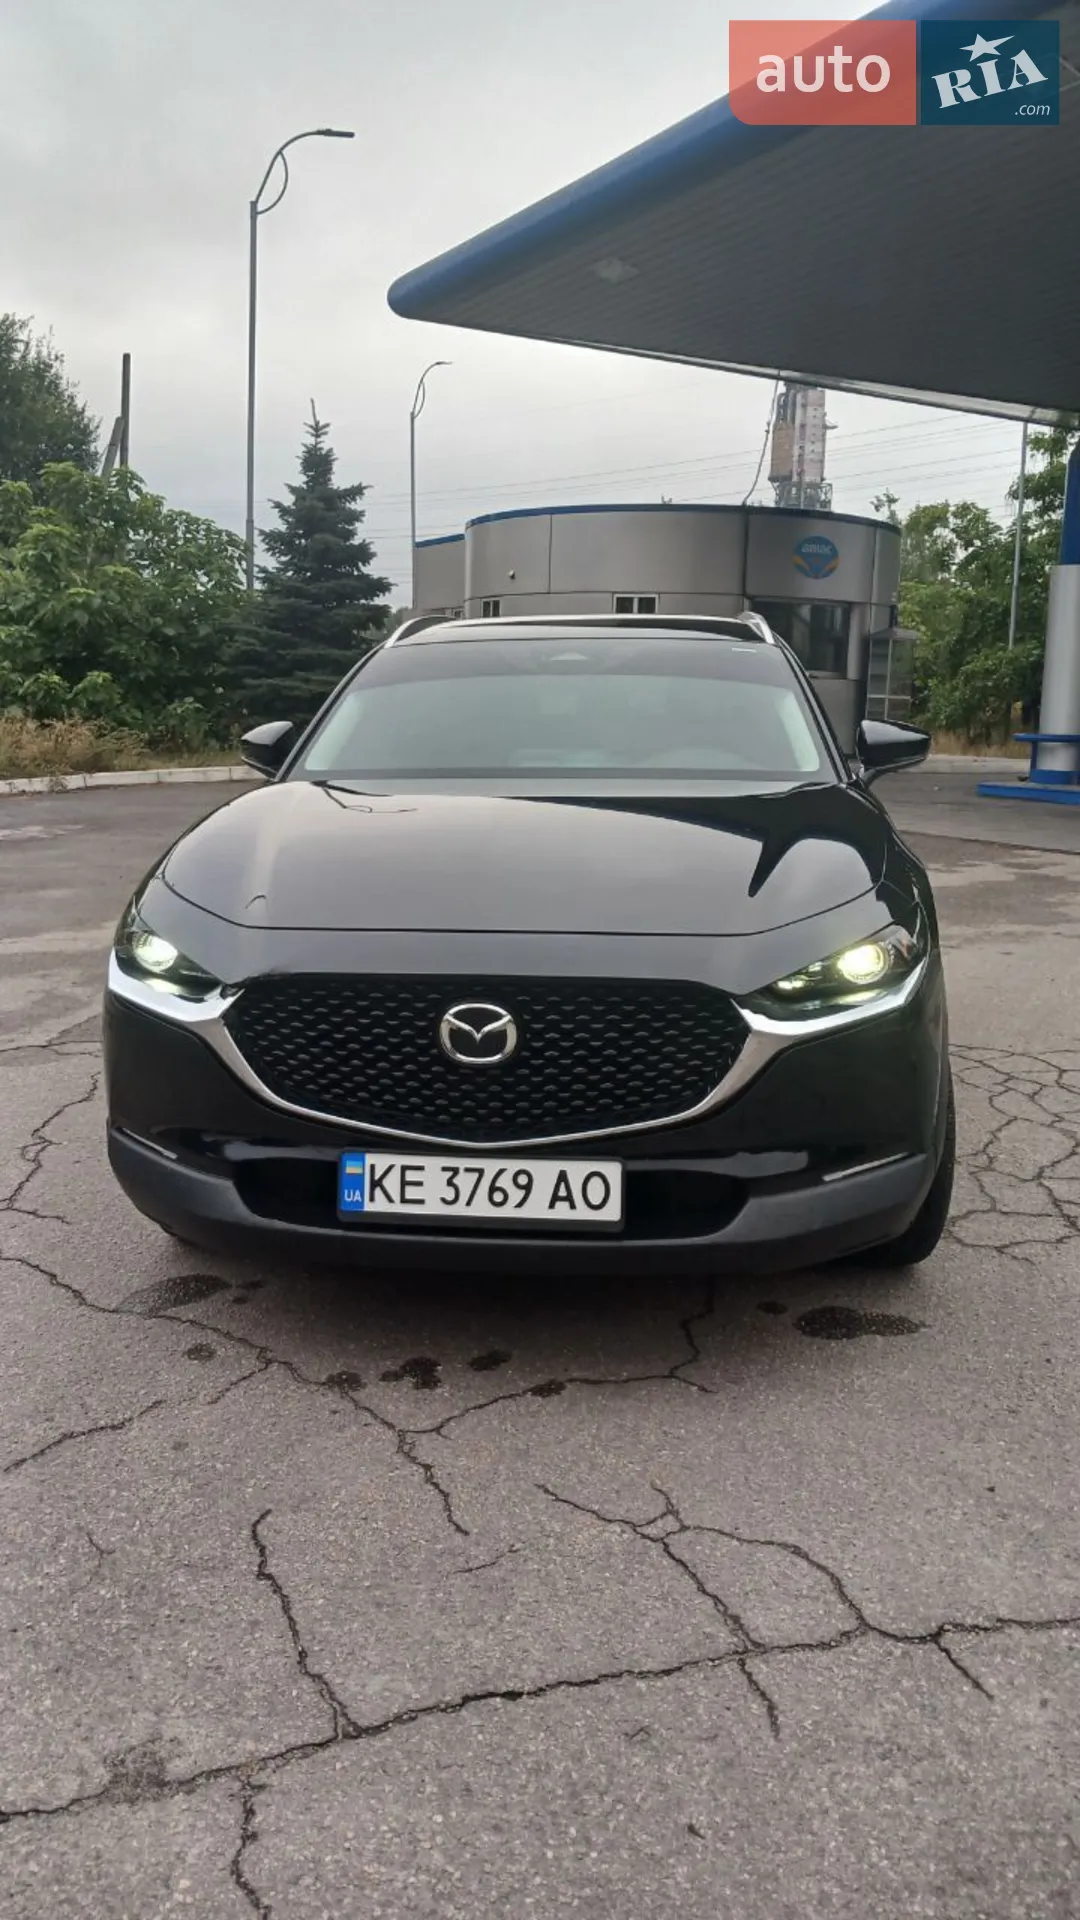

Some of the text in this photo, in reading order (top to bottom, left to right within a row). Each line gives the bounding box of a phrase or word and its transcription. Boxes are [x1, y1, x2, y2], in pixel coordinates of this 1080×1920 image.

[343, 1189, 362, 1203] UA
[368, 1163, 611, 1211] KE 3769 AO
